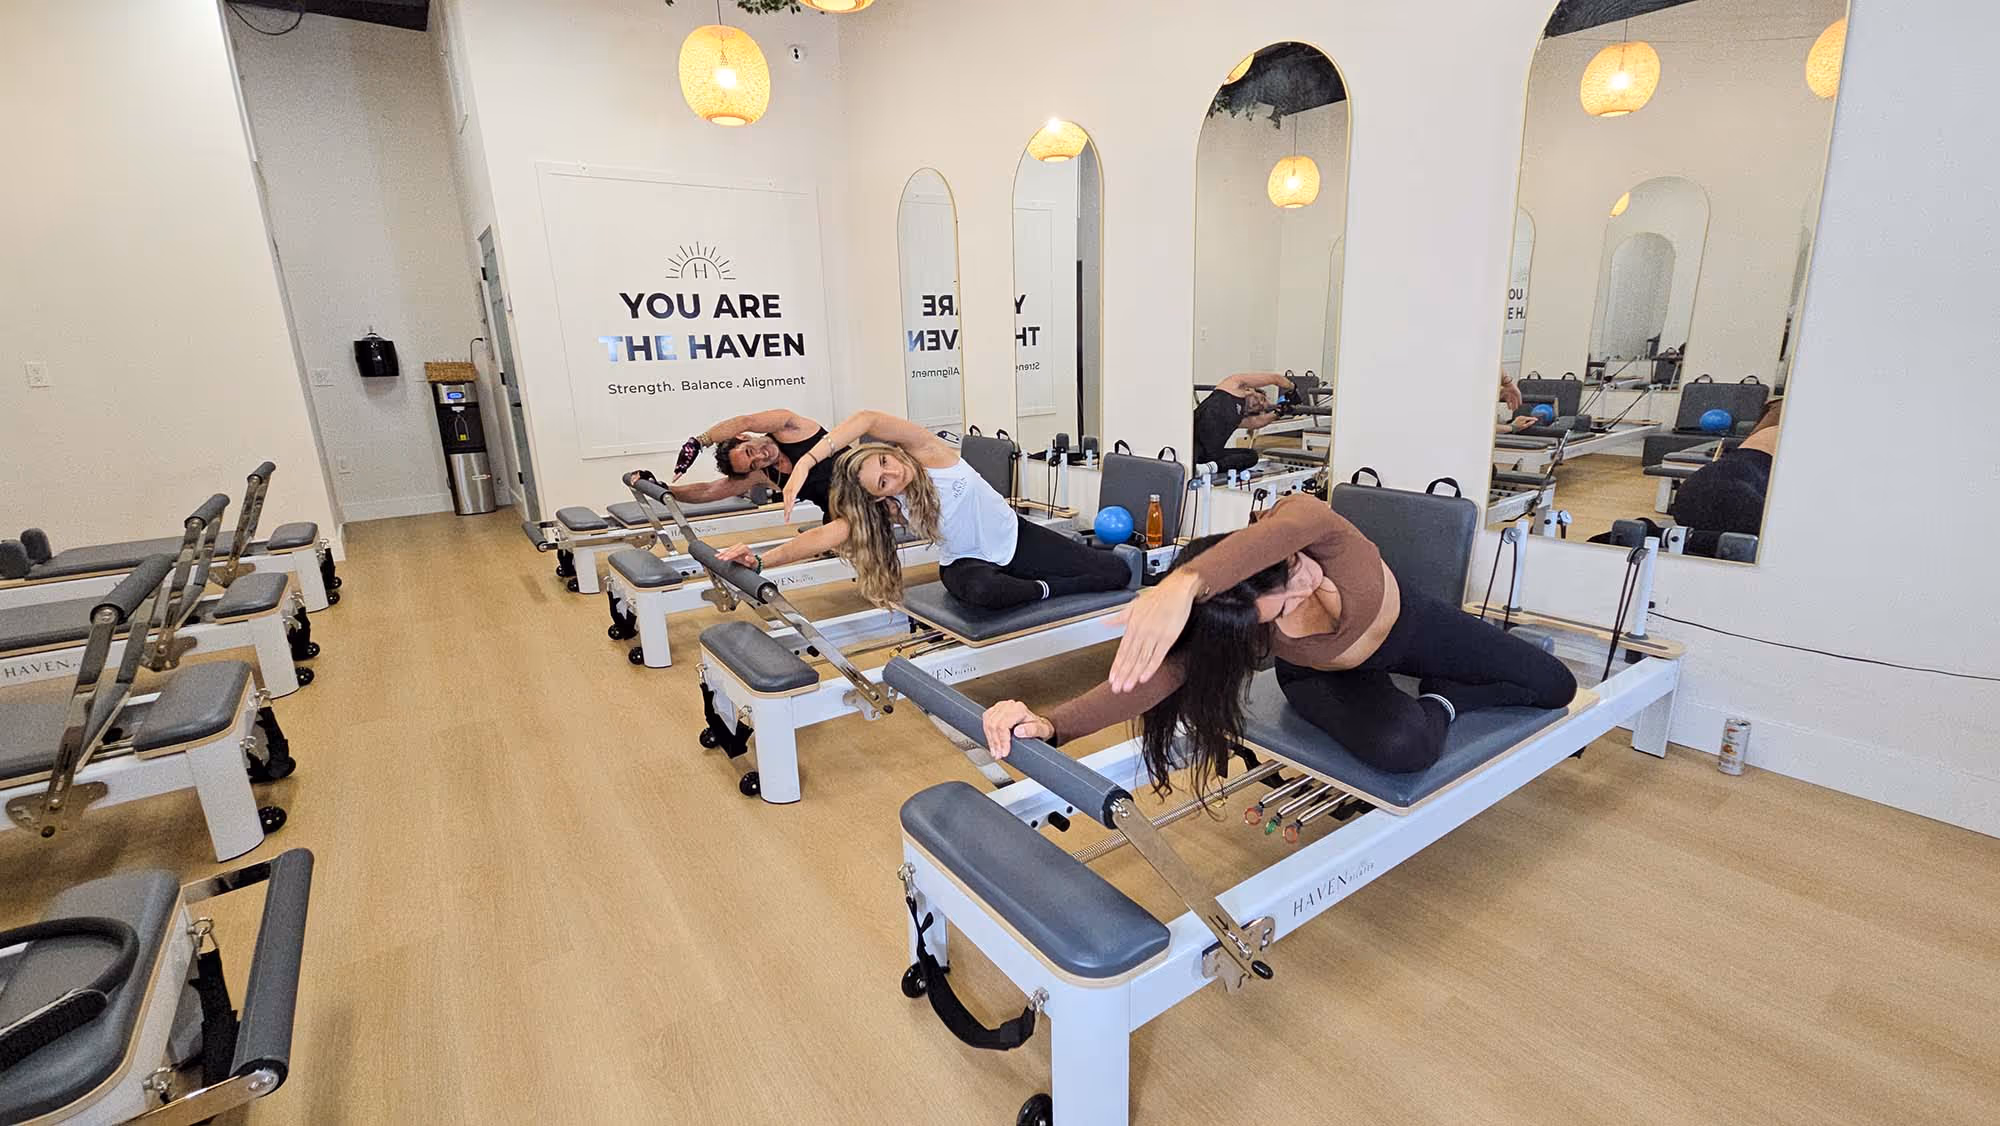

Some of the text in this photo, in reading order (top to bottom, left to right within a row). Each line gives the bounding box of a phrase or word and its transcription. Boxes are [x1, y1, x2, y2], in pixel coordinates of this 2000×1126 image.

[694, 263, 707, 279] H
[1508, 288, 1523, 300] OU
[619, 293, 782, 319] YOU ARE
[598, 333, 805, 362] THE HAVEN
[608, 381, 675, 395] Strength.
[681, 380, 733, 391] Balance
[742, 376, 806, 389] Alignment
[4, 660, 69, 678] HAVEN
[1293, 871, 1348, 917] HAVEN
